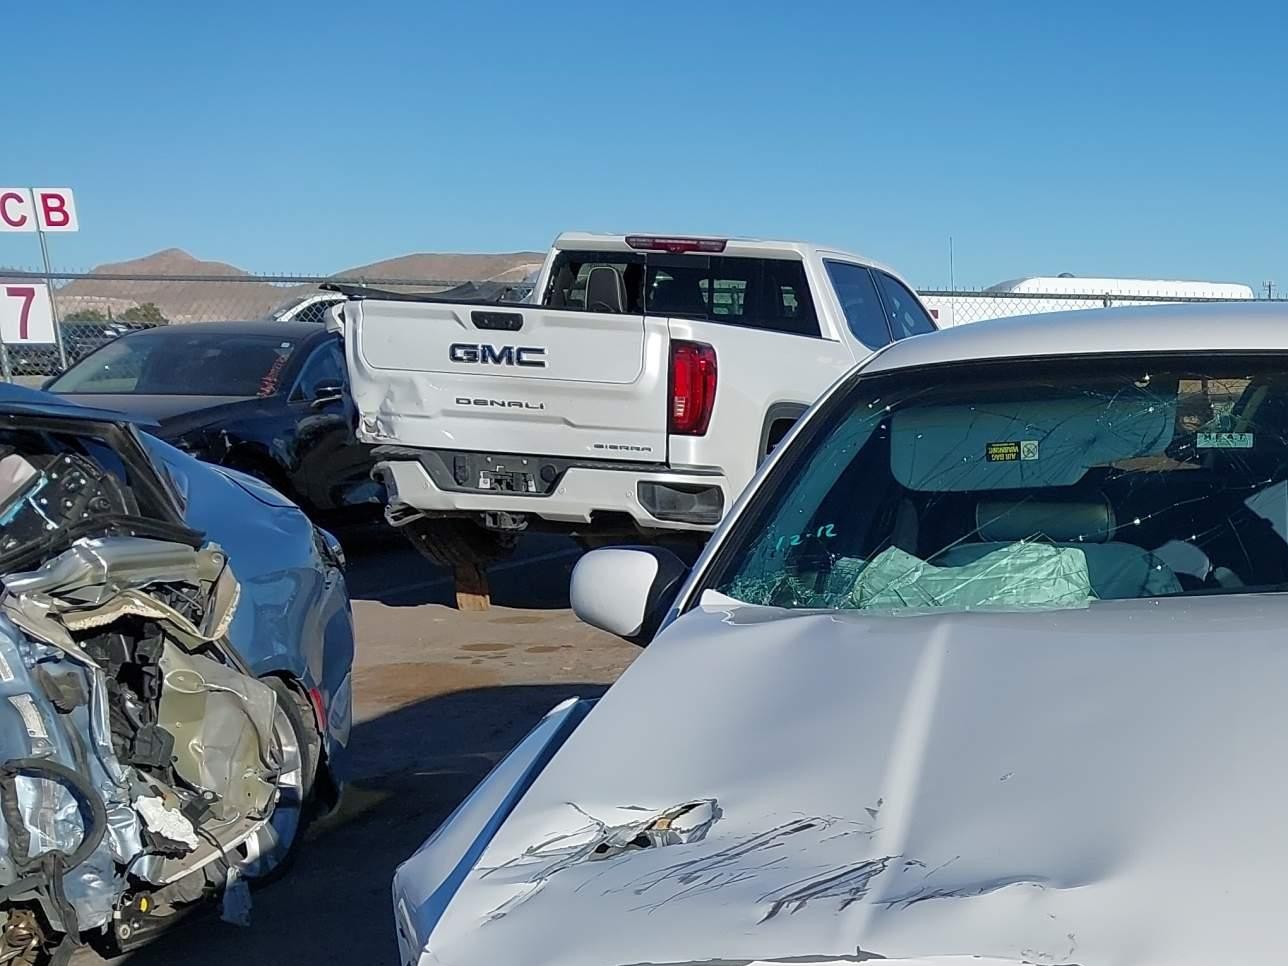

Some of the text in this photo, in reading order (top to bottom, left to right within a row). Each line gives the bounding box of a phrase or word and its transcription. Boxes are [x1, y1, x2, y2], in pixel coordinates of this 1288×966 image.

[0, 193, 27, 227] C
[40, 193, 70, 227] B
[6, 287, 35, 340] 7
[449, 343, 547, 368] GMC
[455, 397, 545, 410] DENALI
[593, 443, 652, 452] SIERRA
